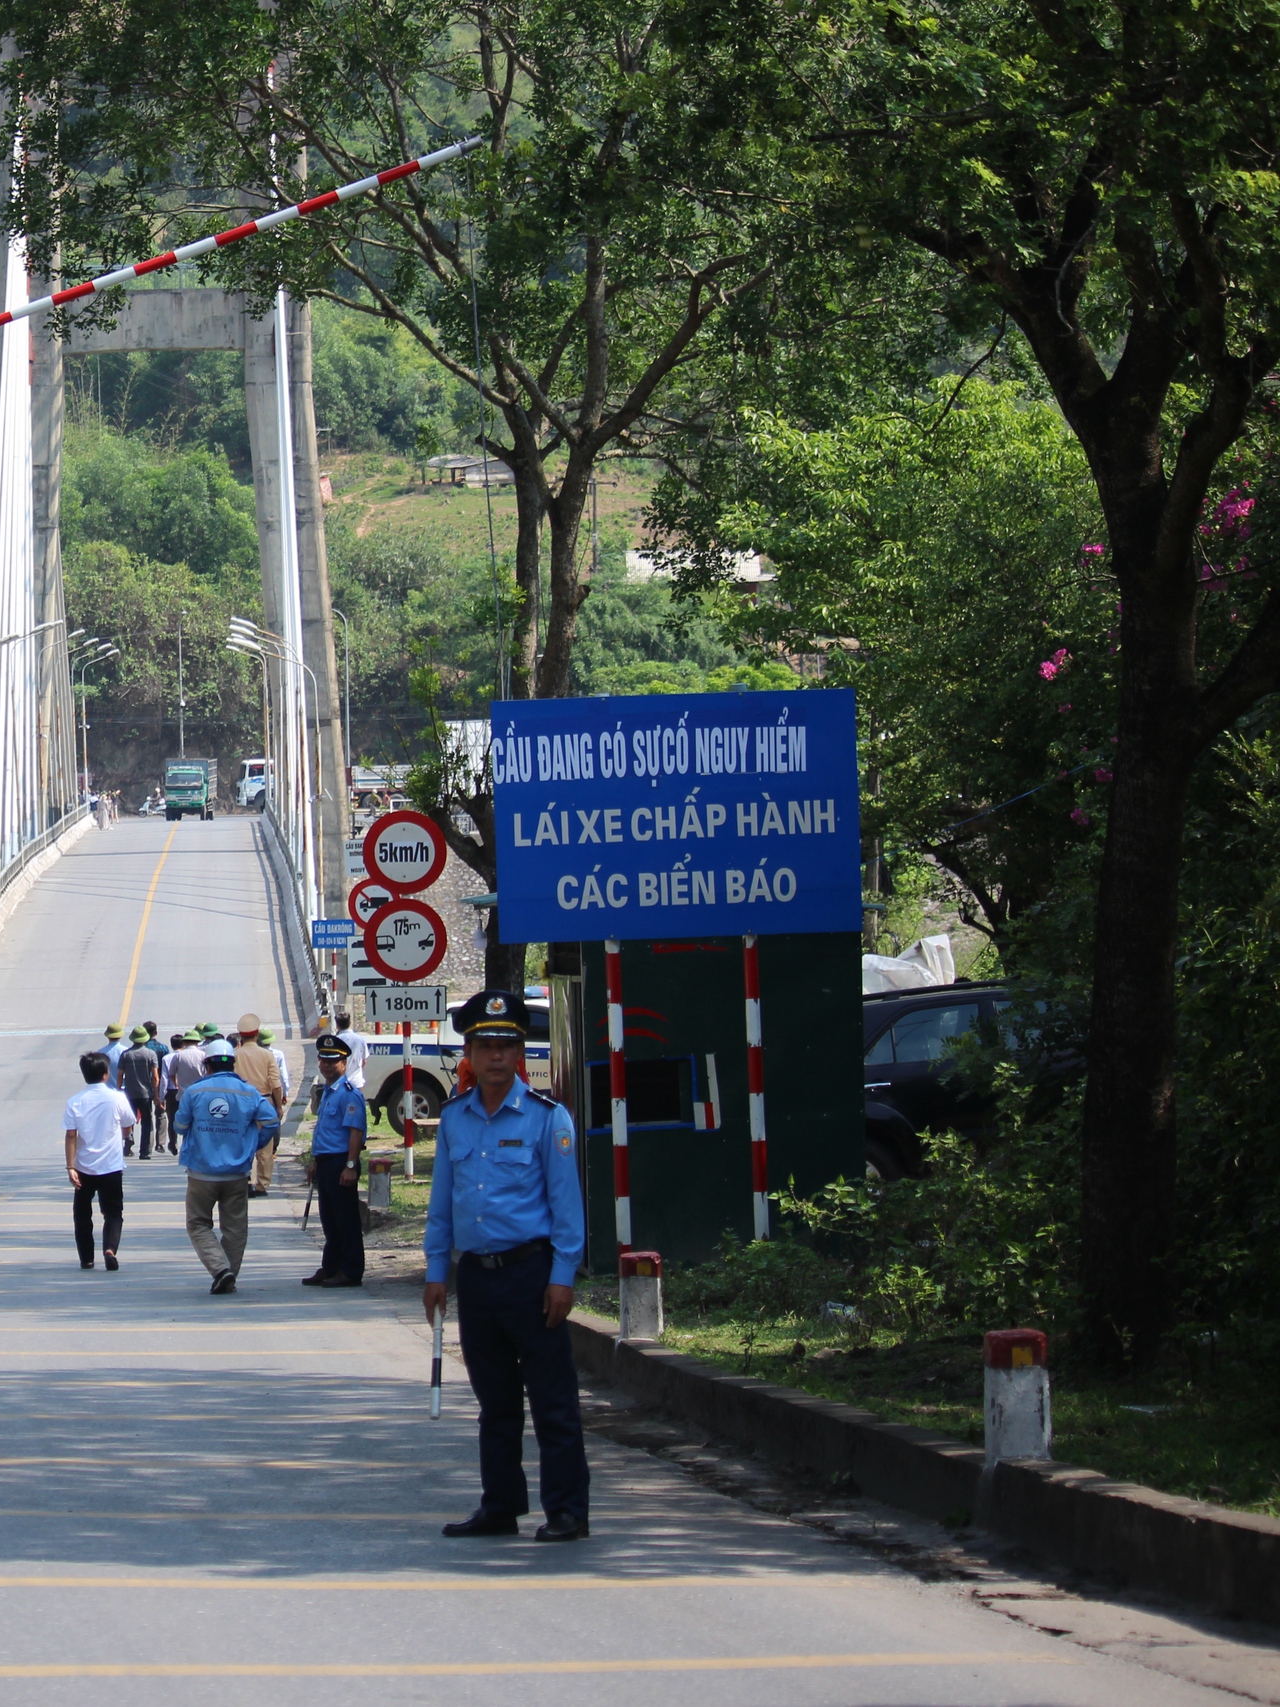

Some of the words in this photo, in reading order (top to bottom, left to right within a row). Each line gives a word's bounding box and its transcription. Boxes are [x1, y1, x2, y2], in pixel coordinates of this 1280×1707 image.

[492, 721, 531, 785] CẦU
[537, 732, 594, 781] ĐANG
[599, 721, 625, 778] CÓ
[633, 724, 661, 787] SỰ
[662, 711, 689, 775] CỐ
[695, 727, 750, 774] NGUY
[756, 706, 807, 773] HIỂM
[514, 802, 570, 847] LÁI
[578, 808, 623, 844] XE
[631, 787, 727, 842] CHẤP
[736, 792, 835, 837] HÀNH
[379, 842, 429, 863] 5km/h
[557, 864, 629, 910] CÁC
[638, 853, 716, 907] BIỂN
[725, 858, 797, 904] BÁO
[393, 919, 421, 936] 175m
[385, 997, 429, 1011] 180m
[411, 1044, 423, 1056] ÁT
